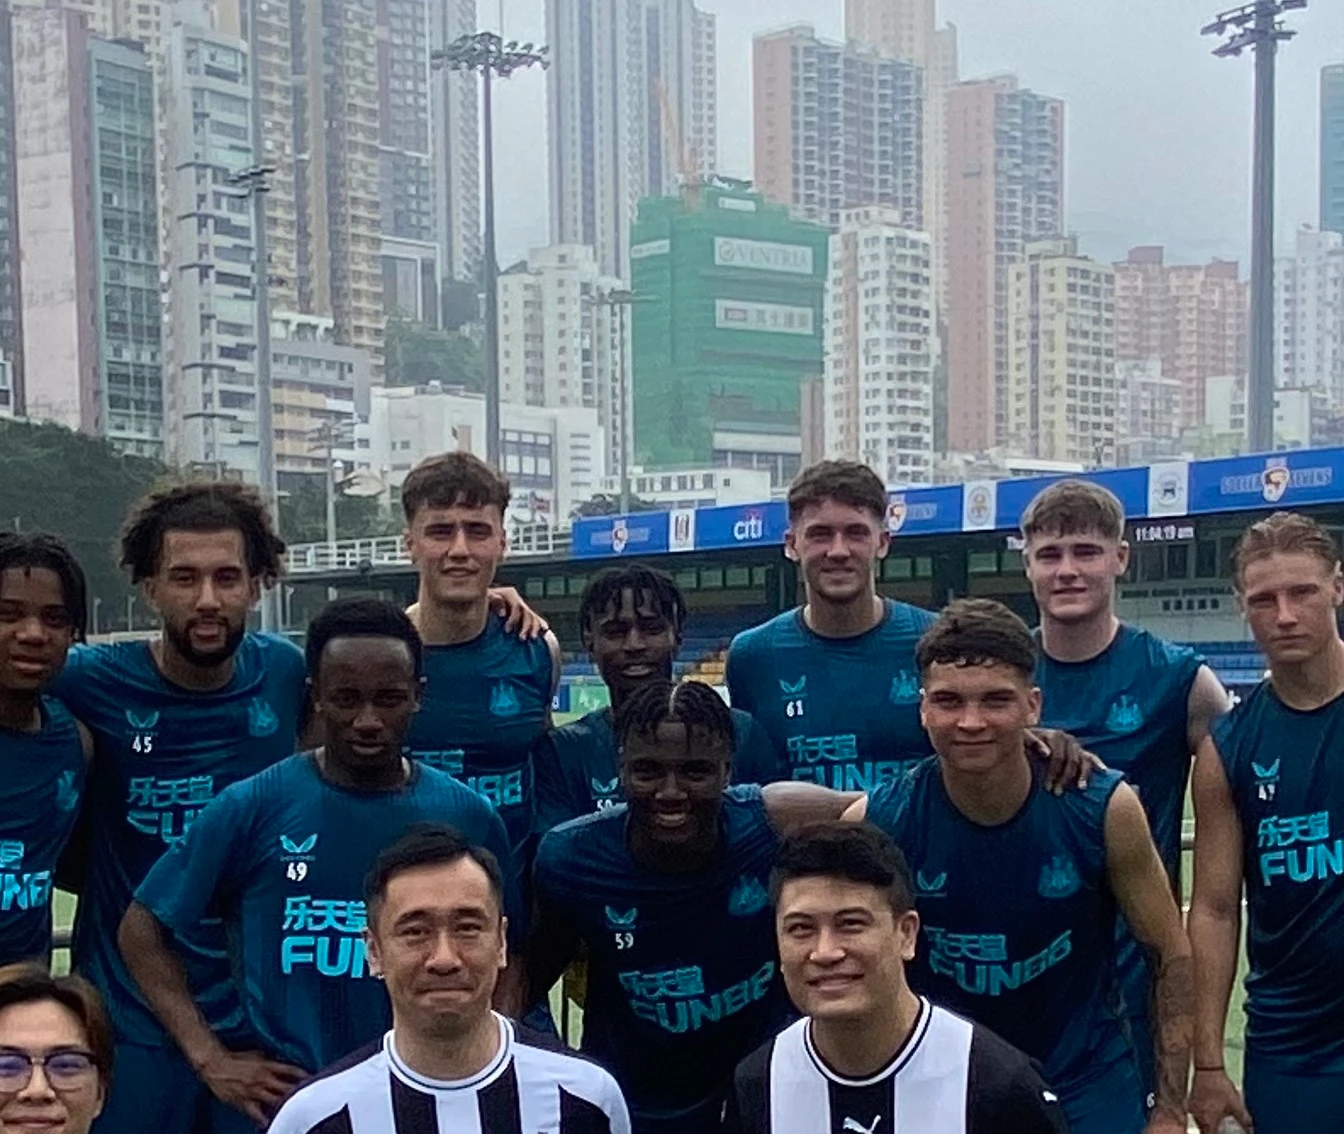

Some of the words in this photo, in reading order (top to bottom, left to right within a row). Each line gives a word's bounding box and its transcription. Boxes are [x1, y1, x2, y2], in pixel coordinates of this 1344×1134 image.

[733, 515, 764, 541] citi
[131, 735, 153, 754] 45
[285, 861, 308, 882] 49
[614, 932, 634, 950] 59
